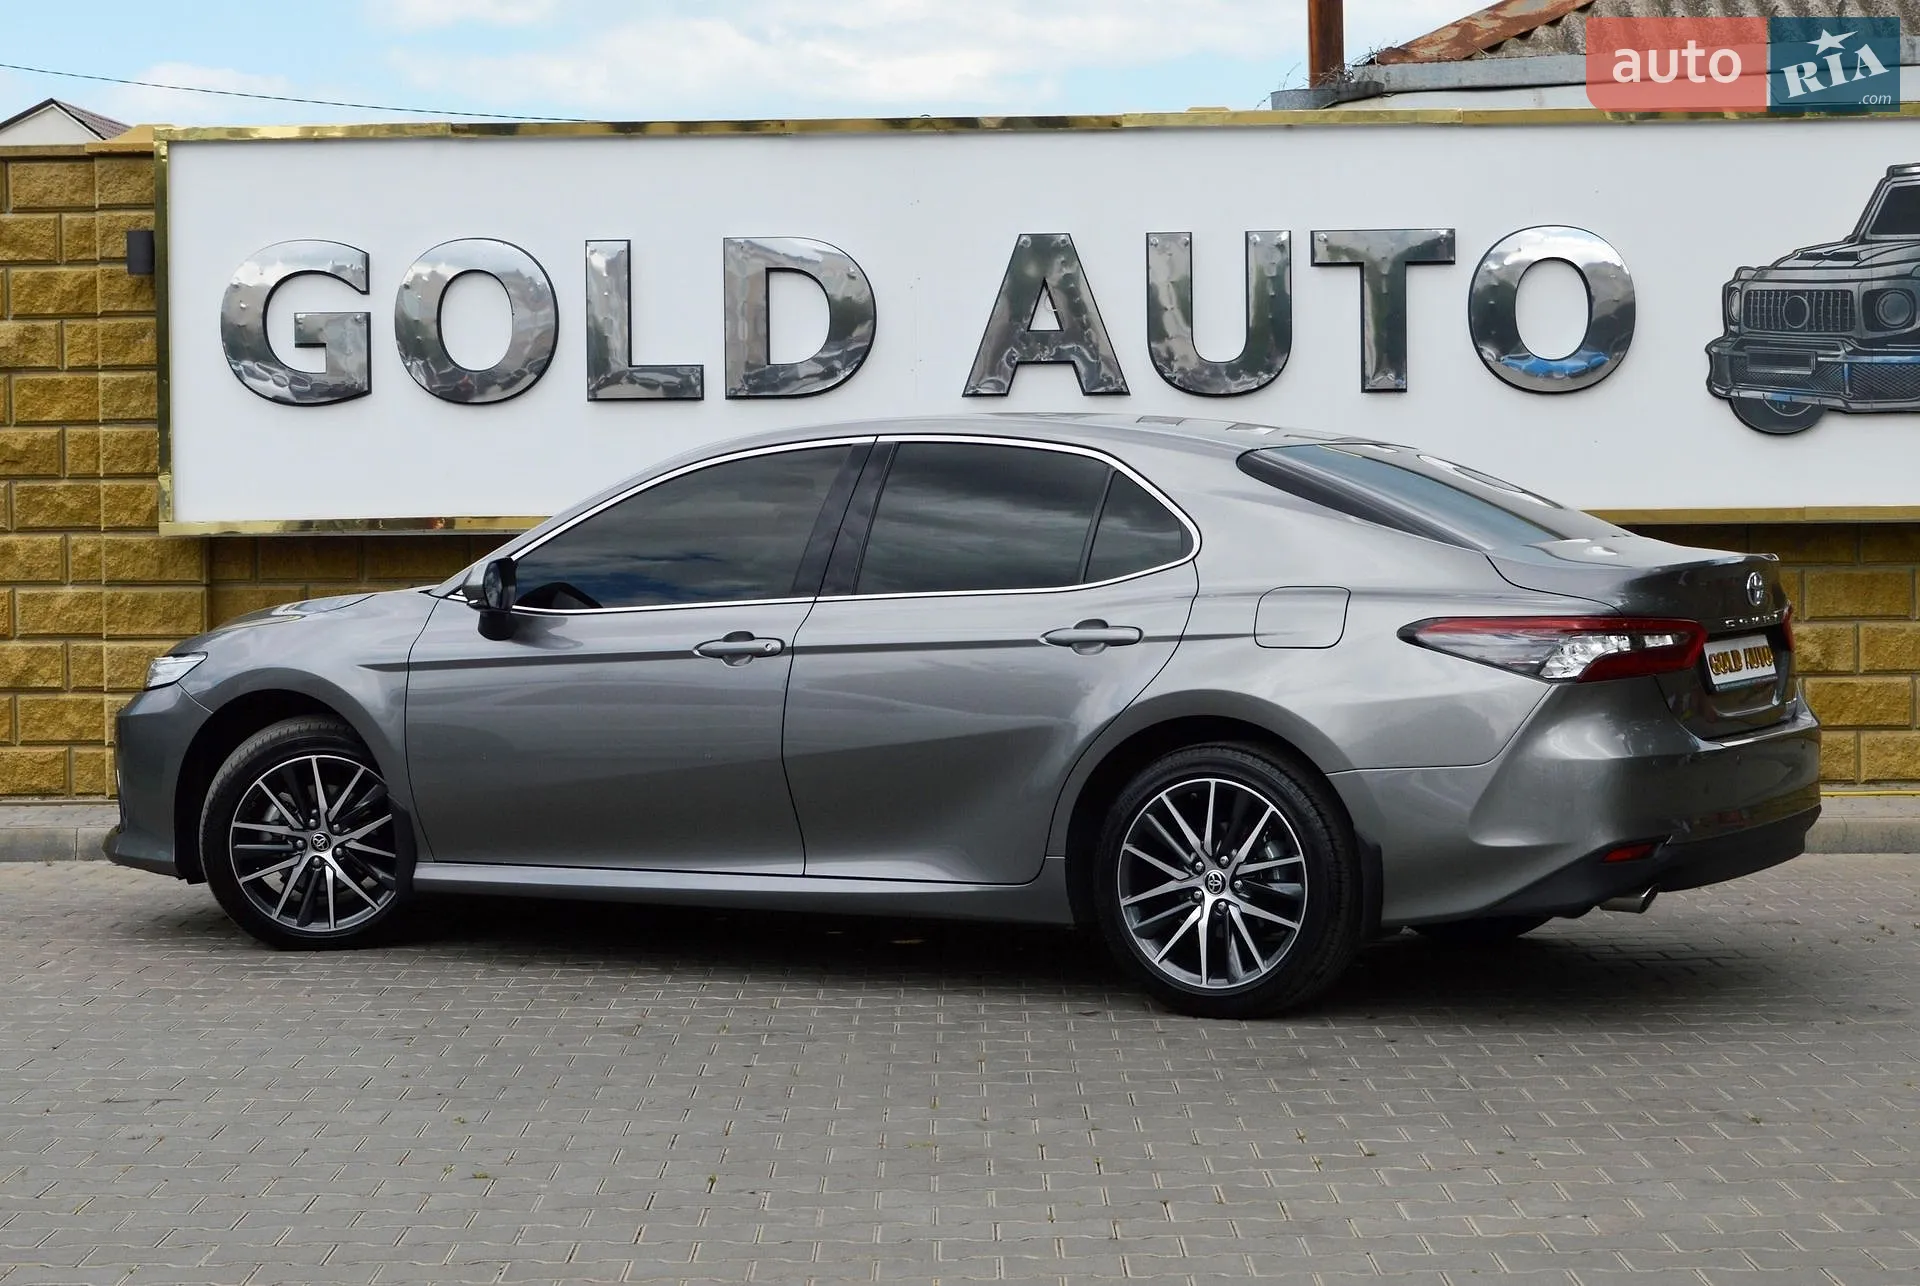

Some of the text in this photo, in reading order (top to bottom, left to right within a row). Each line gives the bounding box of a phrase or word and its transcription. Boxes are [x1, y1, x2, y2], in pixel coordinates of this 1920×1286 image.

[220, 224, 1637, 406] GOLD AUTO
[1709, 649, 1742, 675] GOLD
